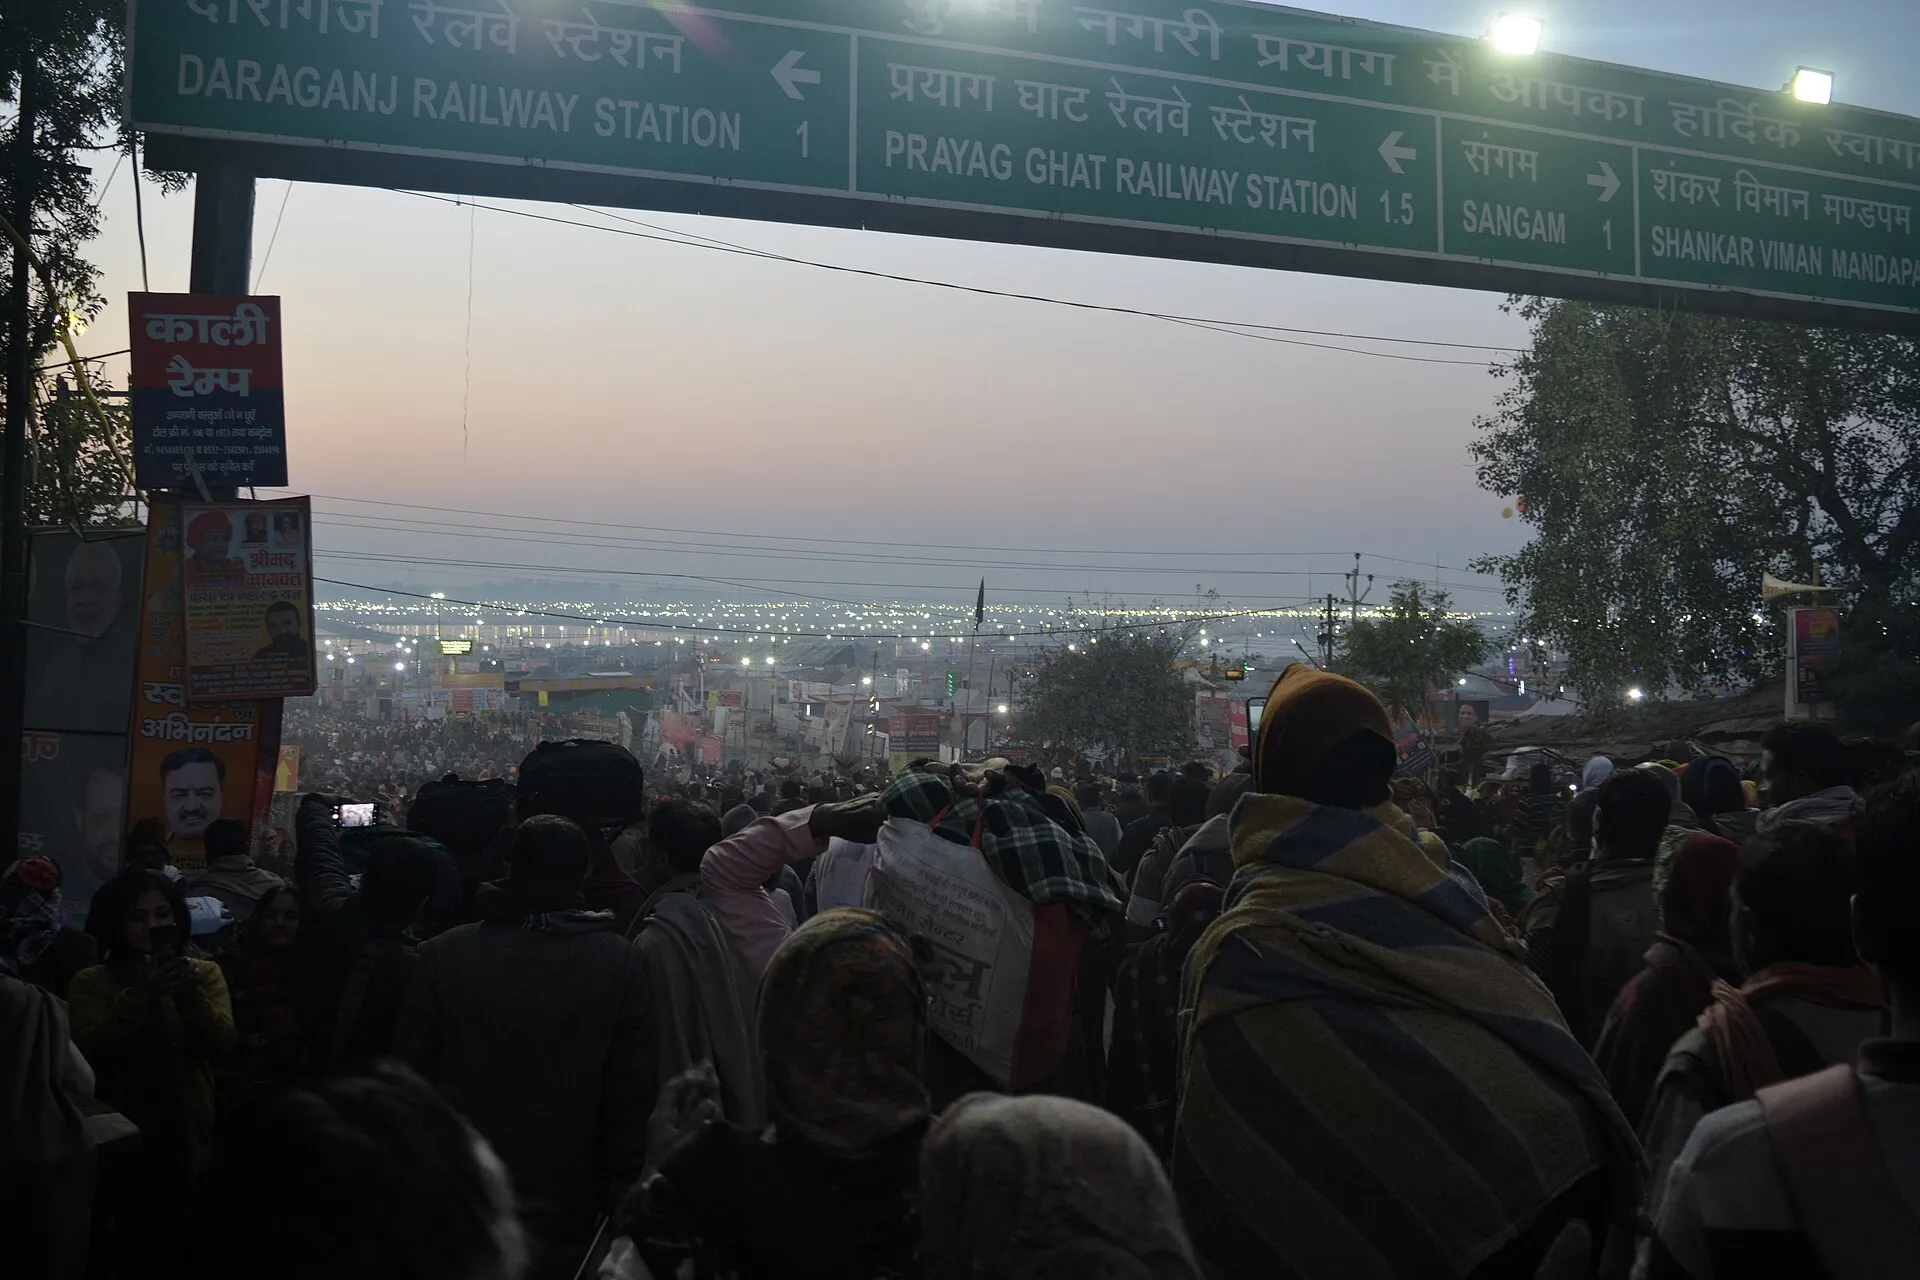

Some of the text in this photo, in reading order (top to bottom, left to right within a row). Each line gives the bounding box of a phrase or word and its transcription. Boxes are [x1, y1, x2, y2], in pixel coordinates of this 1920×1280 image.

[186, 0, 383, 39] दारागज
[541, 6, 685, 74] स्टेशन
[177, 53, 742, 151] DARAGANJ RAILWAY STATION
[886, 62, 1317, 153] प्रयाग घाट रेलवे स्टेशन
[1078, 6, 1225, 61] नगरी
[1253, 33, 1396, 86] प्रयाग
[1422, 48, 1463, 96] में
[1489, 75, 1646, 126] आपका
[1668, 98, 1801, 149] हार्दिक
[1821, 127, 1920, 170] स्वाग
[795, 120, 810, 158] 1
[1461, 132, 1539, 183] संगम
[886, 131, 1357, 220] PRAYAG GHAT RAILWAY STATION
[1650, 160, 1912, 235] शंकर विमान मण्डपम
[1380, 190, 1415, 225] 1.5
[1463, 199, 1566, 245] SANGAM
[1602, 220, 1612, 250] 1
[1651, 225, 1756, 268] SHANKAR
[1759, 239, 1823, 276] VIMAN
[142, 303, 270, 346] काली
[166, 353, 253, 398] रैम्प
[140, 711, 256, 744] अभिनंदन
